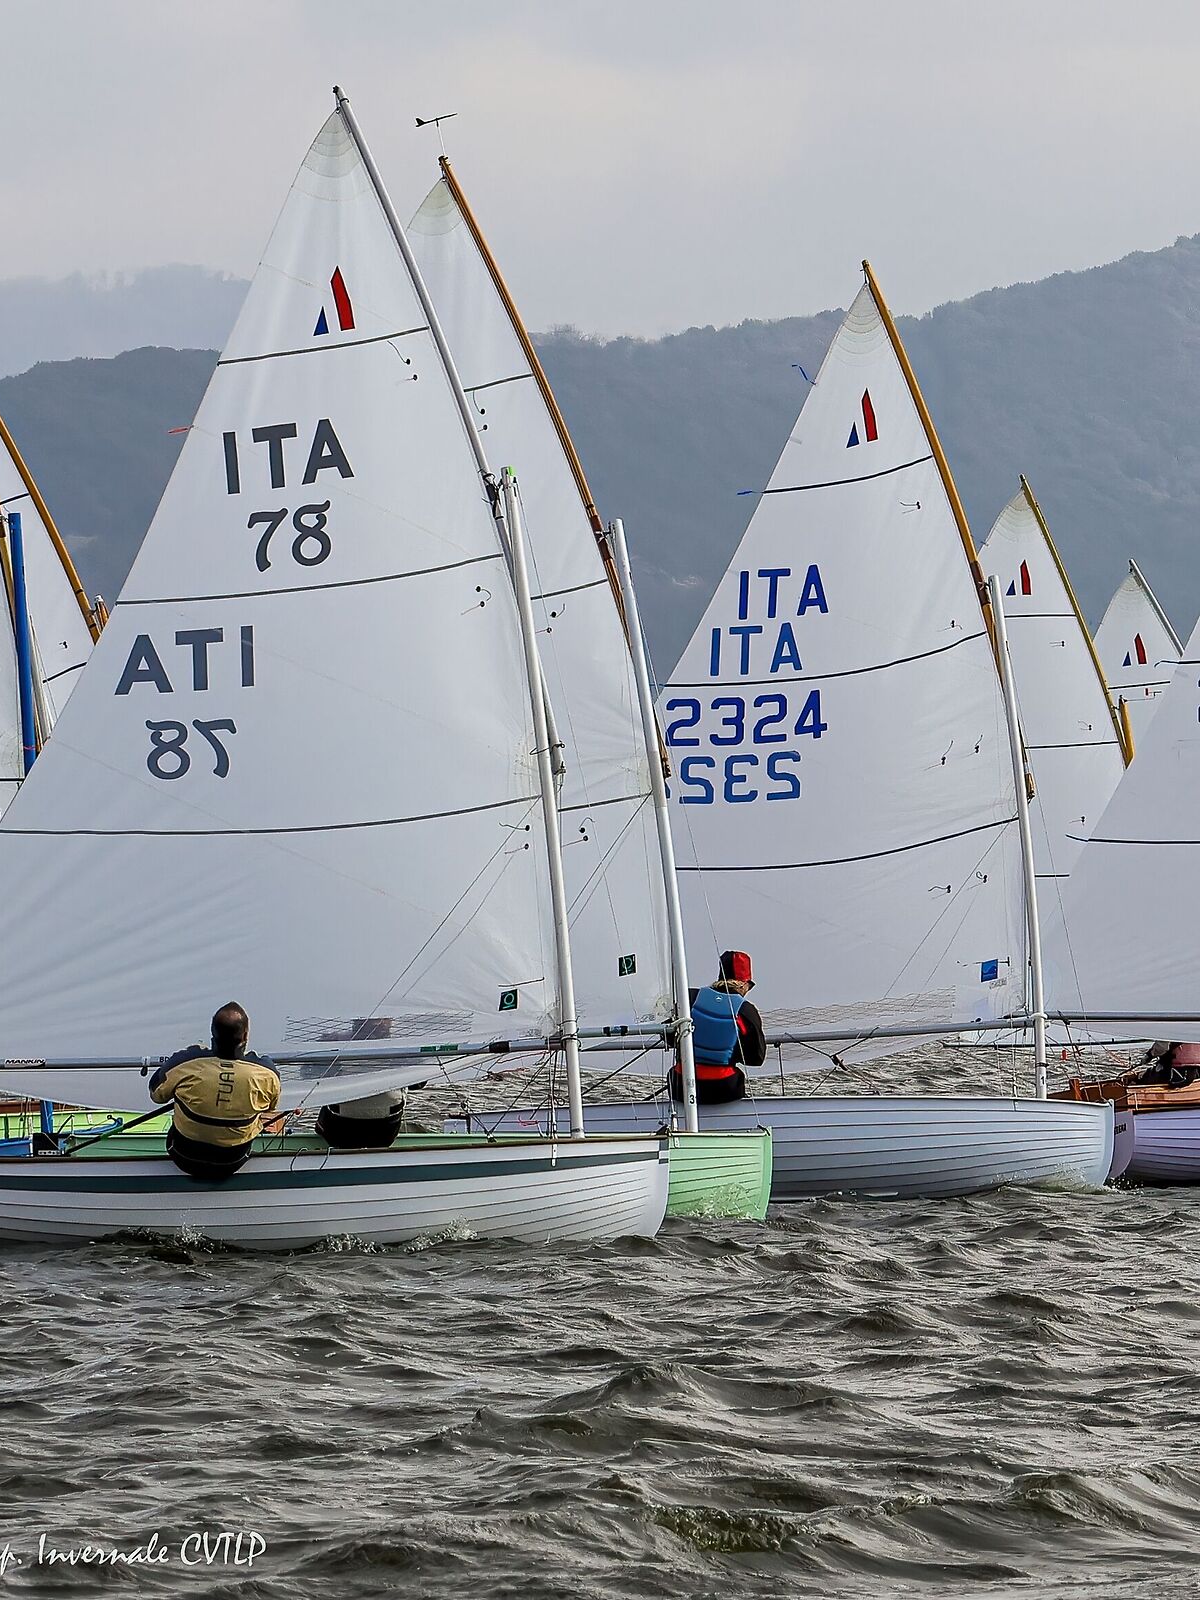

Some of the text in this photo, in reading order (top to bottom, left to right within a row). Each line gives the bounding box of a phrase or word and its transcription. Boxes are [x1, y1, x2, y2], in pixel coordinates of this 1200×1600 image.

[222, 418, 355, 495] ITA
[247, 499, 332, 572] 78
[738, 564, 829, 620] ITA
[709, 622, 803, 677] ITA
[664, 690, 828, 747] 2324
[690, 1095, 695, 1105] 3
